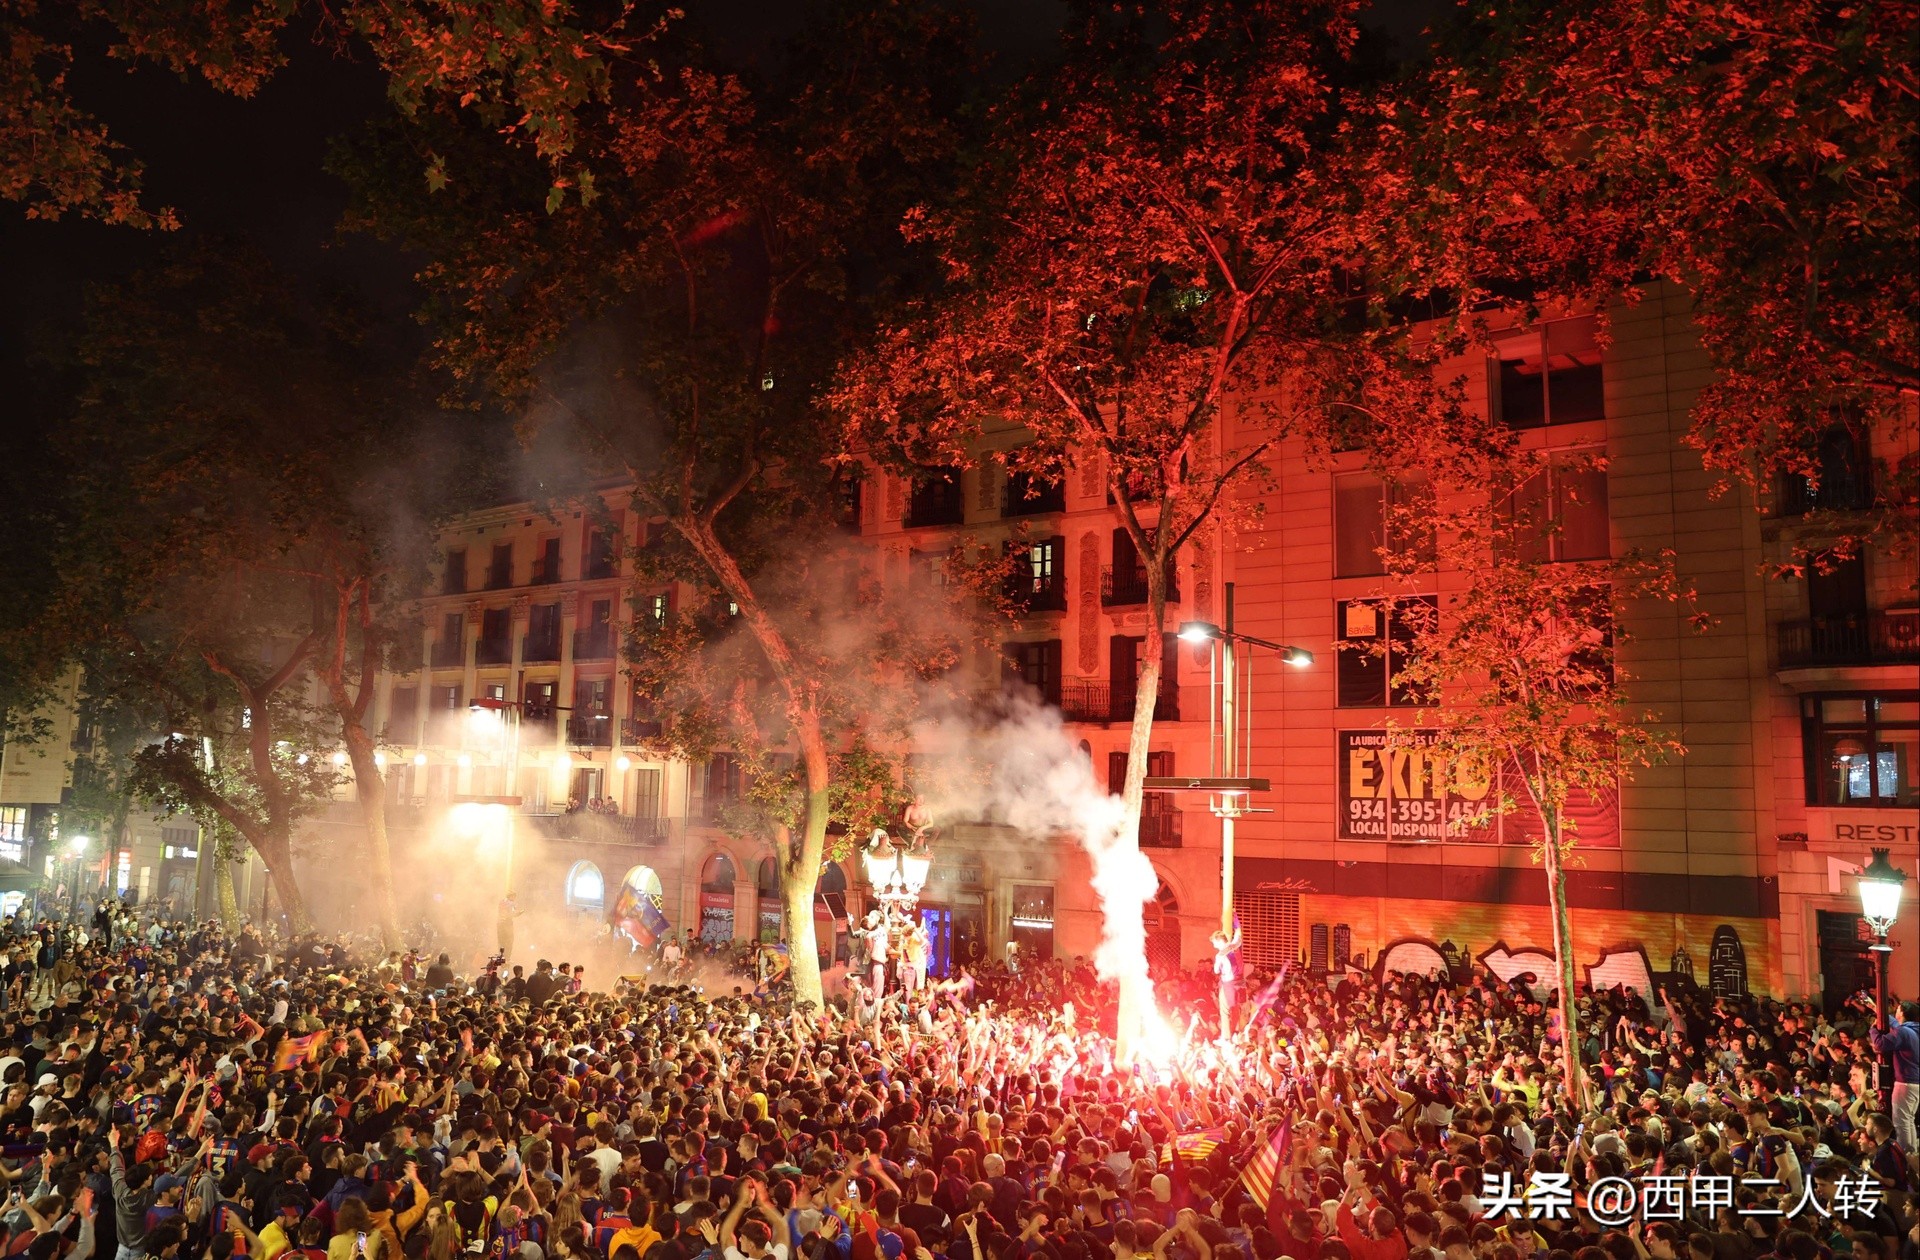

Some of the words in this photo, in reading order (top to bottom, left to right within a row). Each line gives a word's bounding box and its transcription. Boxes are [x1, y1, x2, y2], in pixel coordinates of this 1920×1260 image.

[1347, 625, 1376, 635] savills
[1350, 822, 1386, 834] LOCAL
[1836, 824, 1919, 842] REST
[212, 1157, 227, 1180] 3
